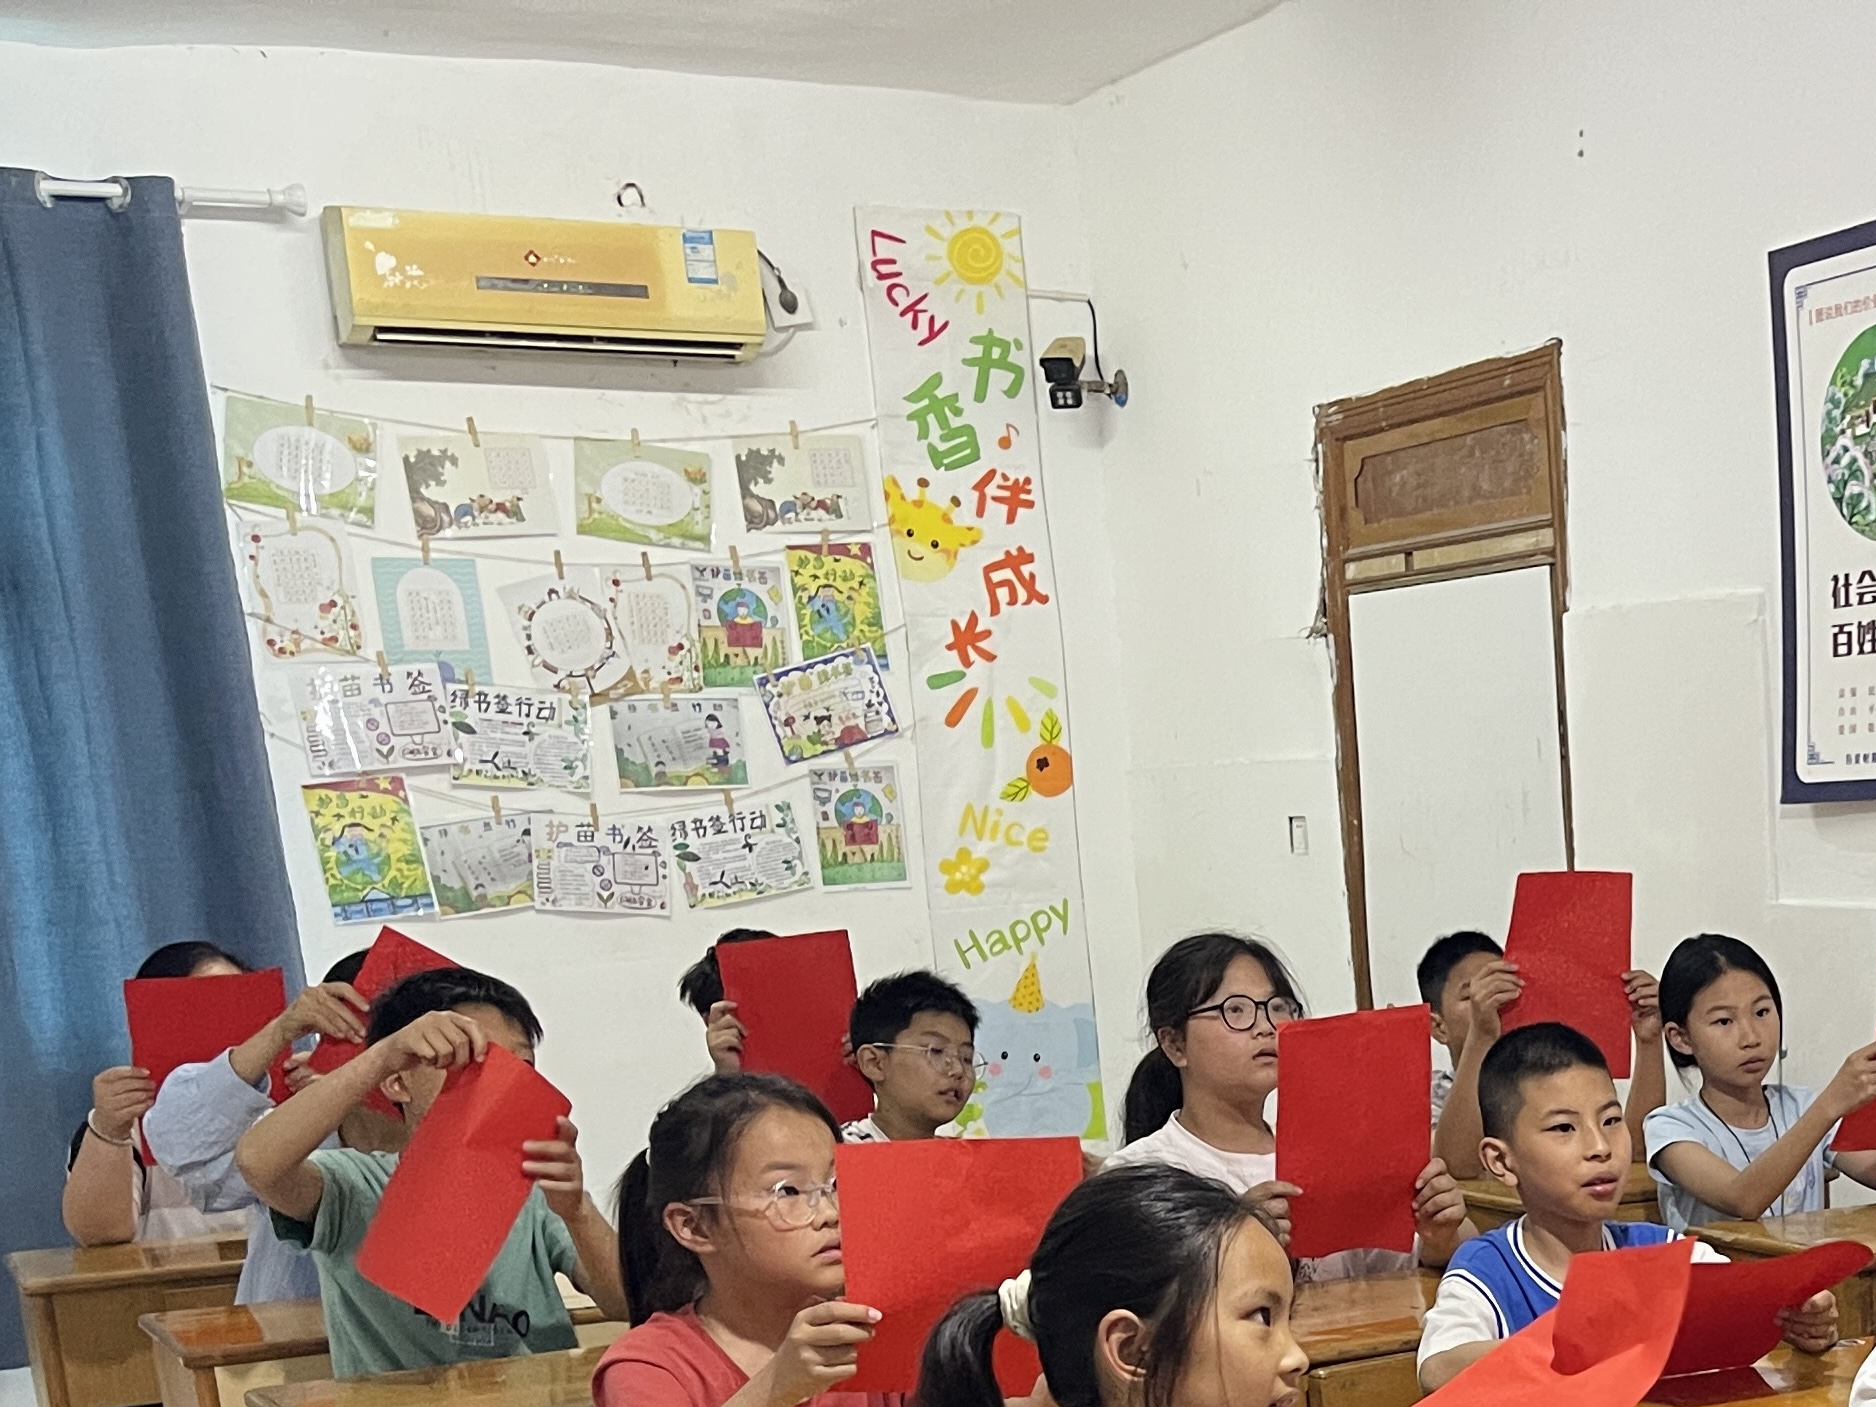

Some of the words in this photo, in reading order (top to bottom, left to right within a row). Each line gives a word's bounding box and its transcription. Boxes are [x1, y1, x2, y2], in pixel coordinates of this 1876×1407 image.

[871, 230, 950, 346] Lucky
[306, 669, 432, 700] 苗书签
[545, 820, 659, 849] 护苗书签
[958, 802, 1049, 852] Nice
[953, 897, 1069, 970] Happy
